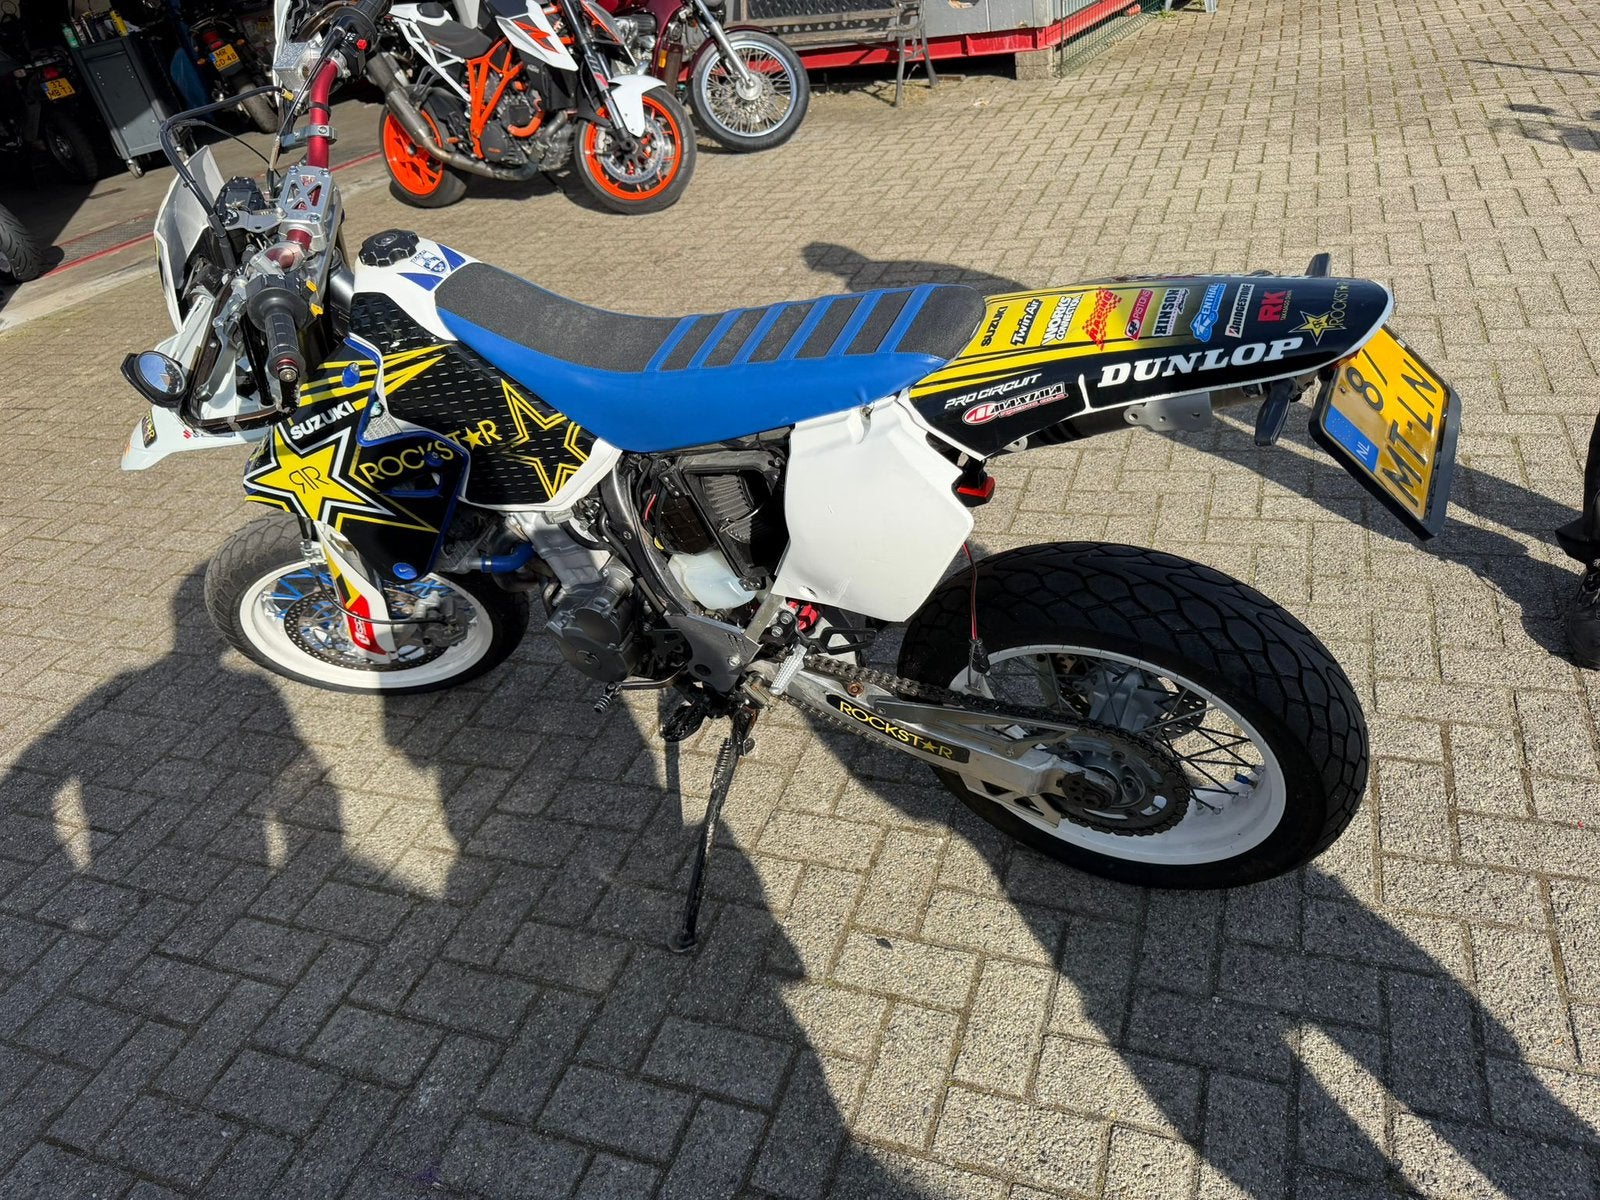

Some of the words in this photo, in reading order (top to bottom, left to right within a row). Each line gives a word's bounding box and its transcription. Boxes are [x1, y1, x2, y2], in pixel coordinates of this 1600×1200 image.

[981, 306, 1008, 347] SUZUKI
[1042, 296, 1071, 346] WORKS
[1088, 290, 1113, 341] RACING
[1154, 289, 1180, 335] HINSON
[1257, 290, 1288, 322] RK
[1097, 337, 1303, 388] DUNLOP
[943, 391, 978, 410] PRO
[977, 373, 1043, 399] CIRCUIT
[290, 400, 356, 440] SUZUKI
[1356, 441, 1371, 461] NL
